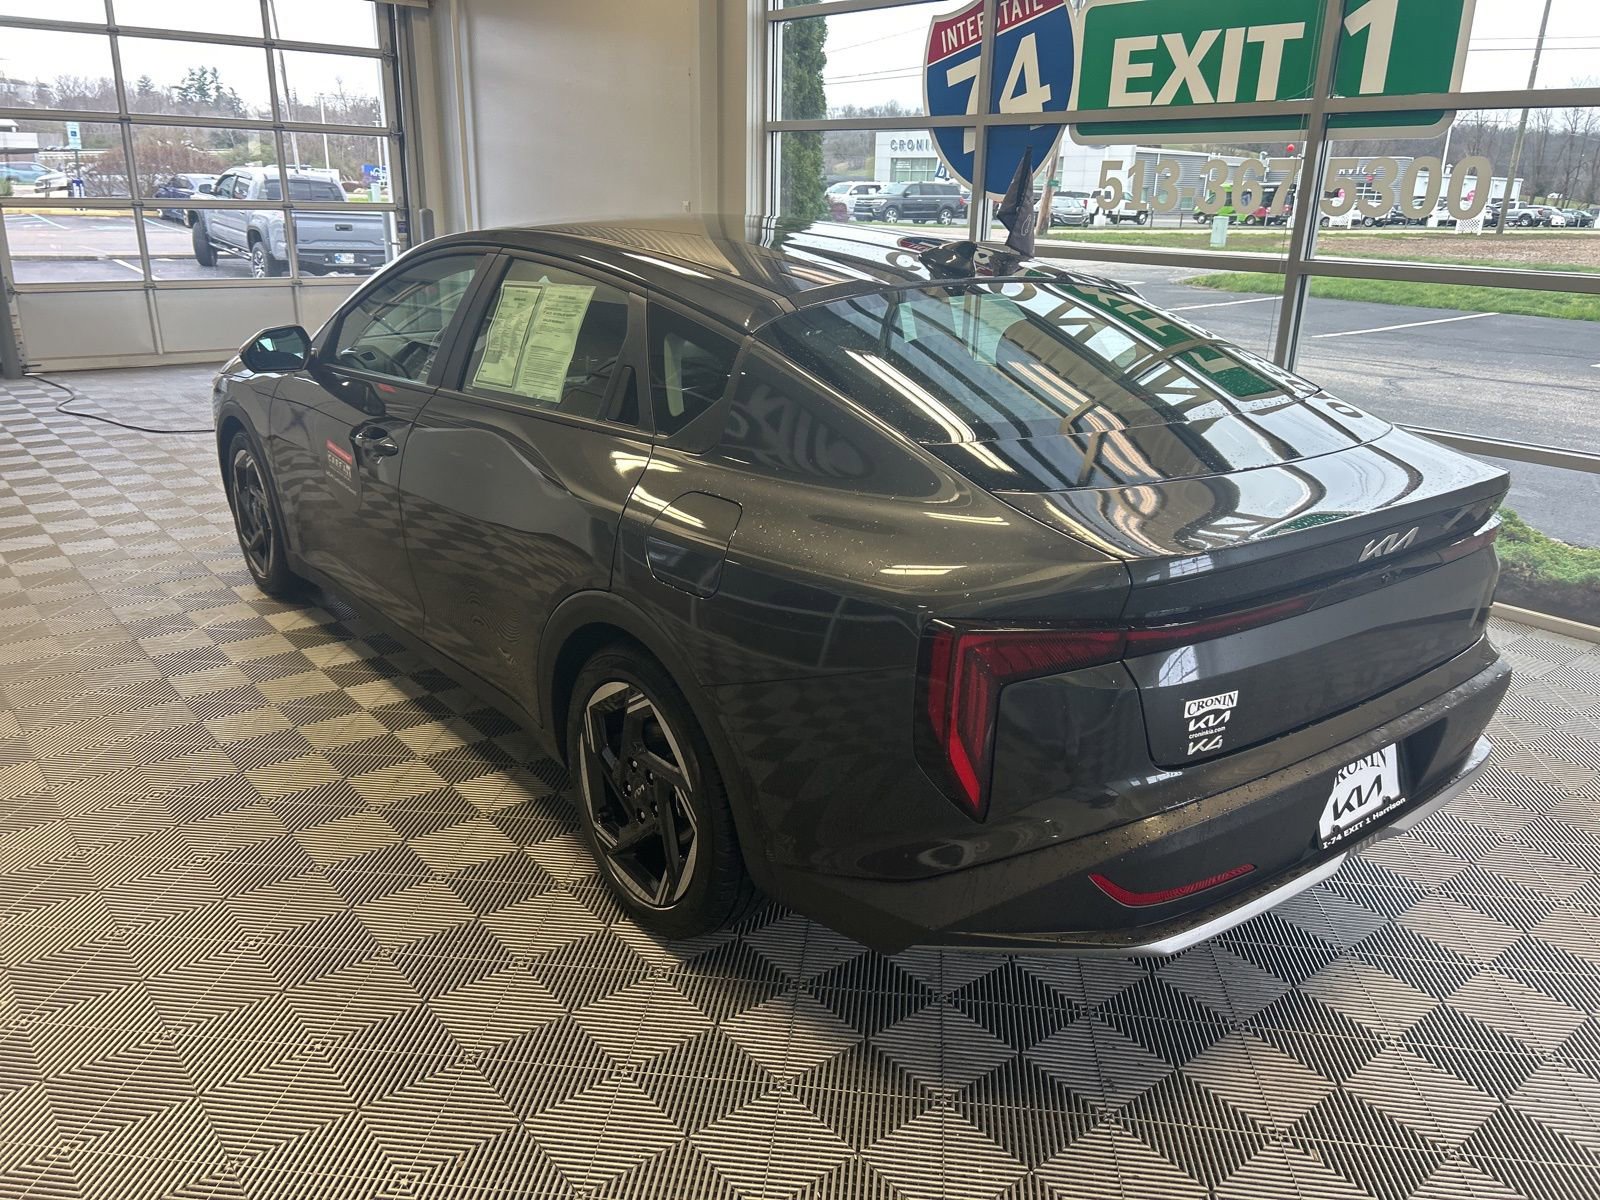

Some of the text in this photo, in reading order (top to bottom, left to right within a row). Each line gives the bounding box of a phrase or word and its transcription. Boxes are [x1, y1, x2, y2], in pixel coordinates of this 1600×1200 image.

[941, 0, 1044, 53] INTERTAT
[1107, 0, 1399, 108] EXIT 1
[946, 32, 1052, 155] 74
[1096, 155, 1493, 220] 513-3675300
[1187, 692, 1236, 716] CRONIN
[1187, 735, 1224, 756] K4
[1188, 726, 1226, 740] croninkia.com
[1336, 749, 1387, 785] RONIN
[1322, 797, 1406, 850] I-74 EXIT 1 Harrison
